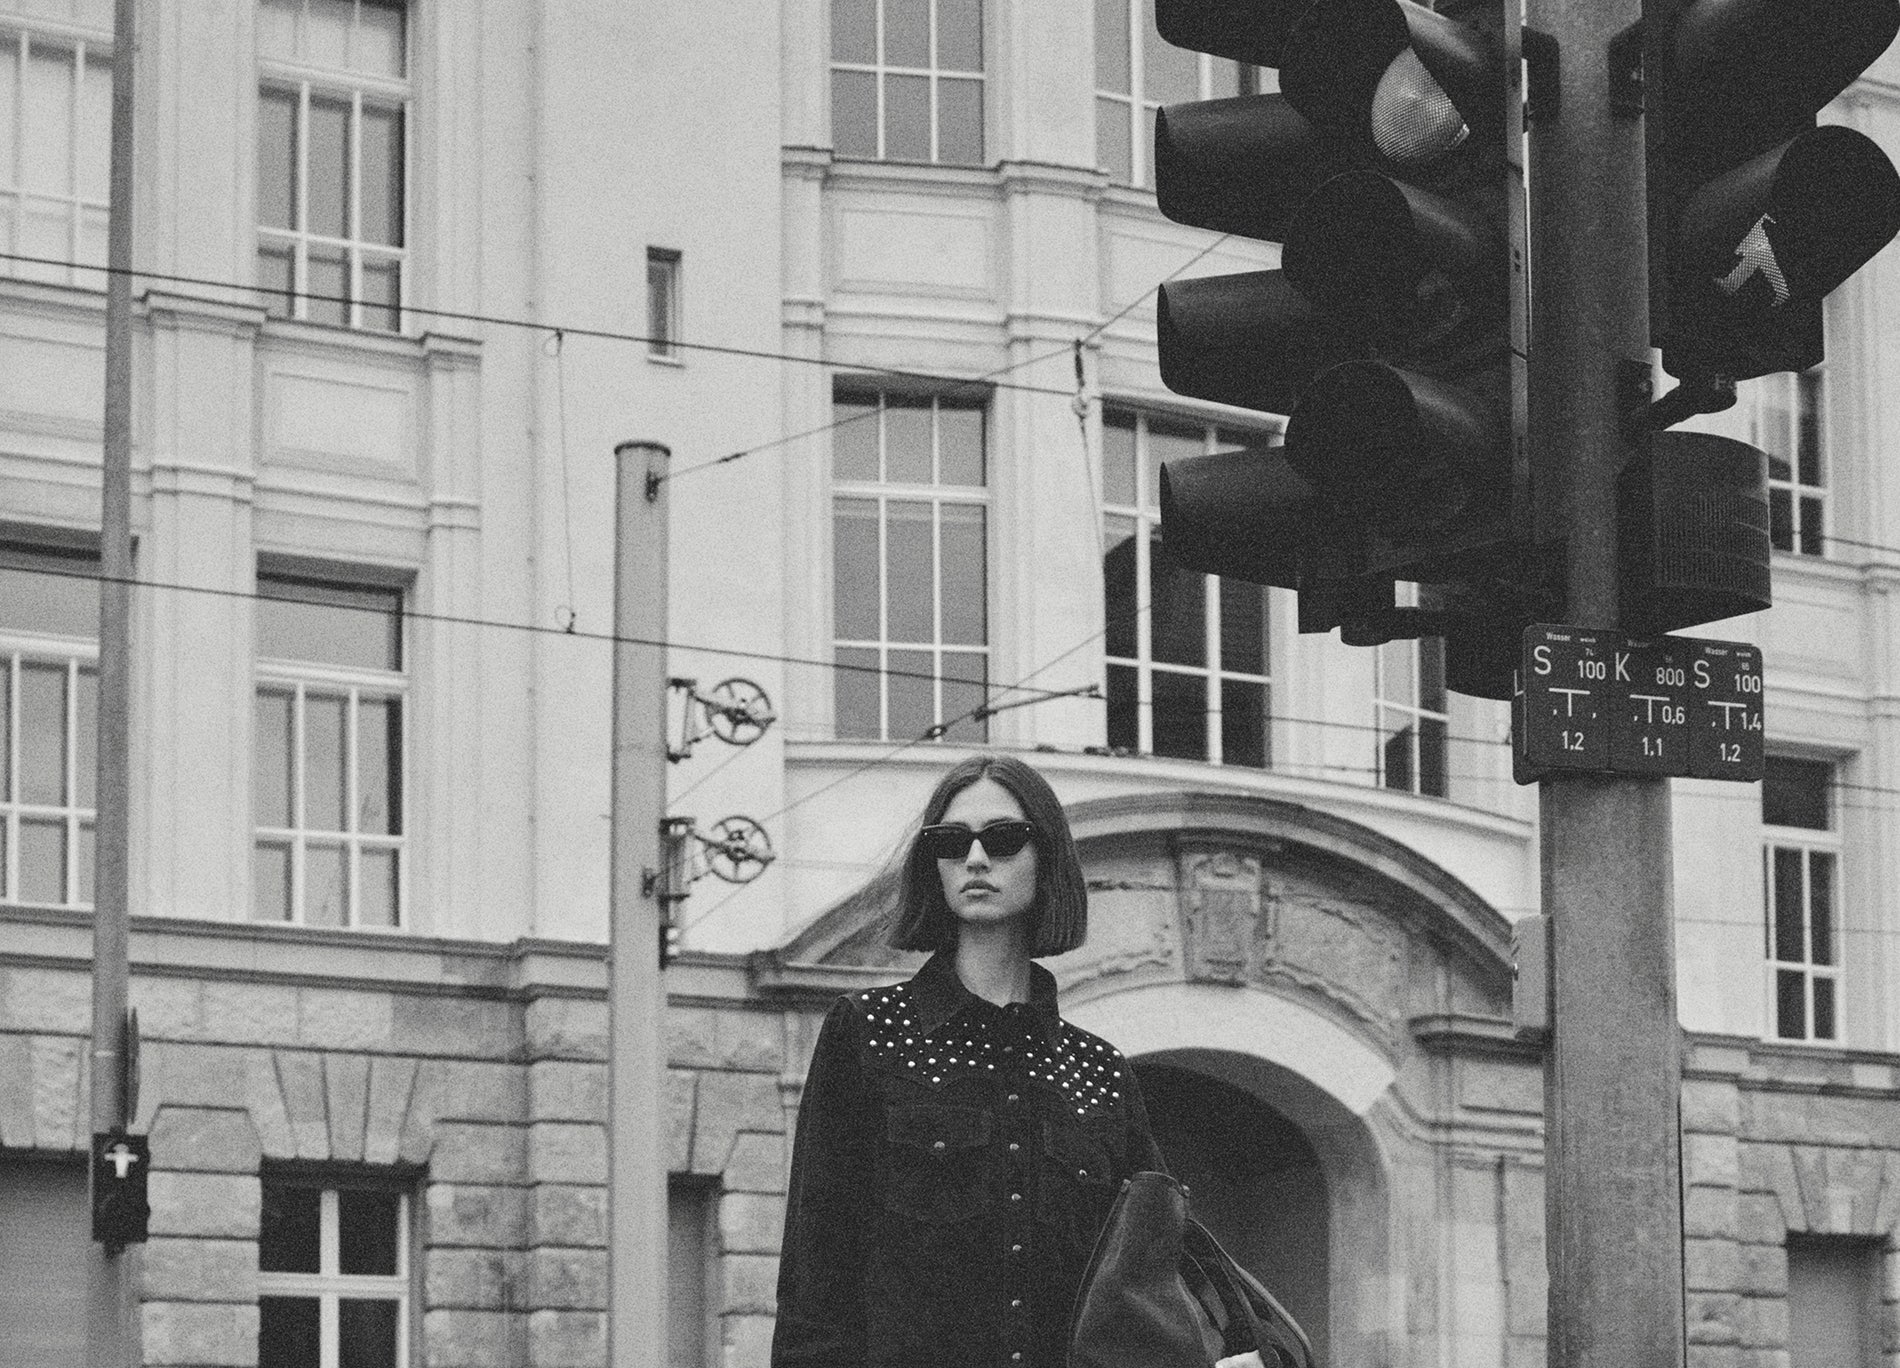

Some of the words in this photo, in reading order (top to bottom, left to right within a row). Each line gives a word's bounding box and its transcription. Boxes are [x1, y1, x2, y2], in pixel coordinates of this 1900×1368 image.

[1546, 632, 1571, 642] Wasser
[1534, 645, 1552, 675] S
[1578, 660, 1607, 680] 100
[1615, 652, 1631, 682] K
[1656, 667, 1685, 687] 800
[1693, 659, 1711, 689] S
[1734, 674, 1762, 694] 100
